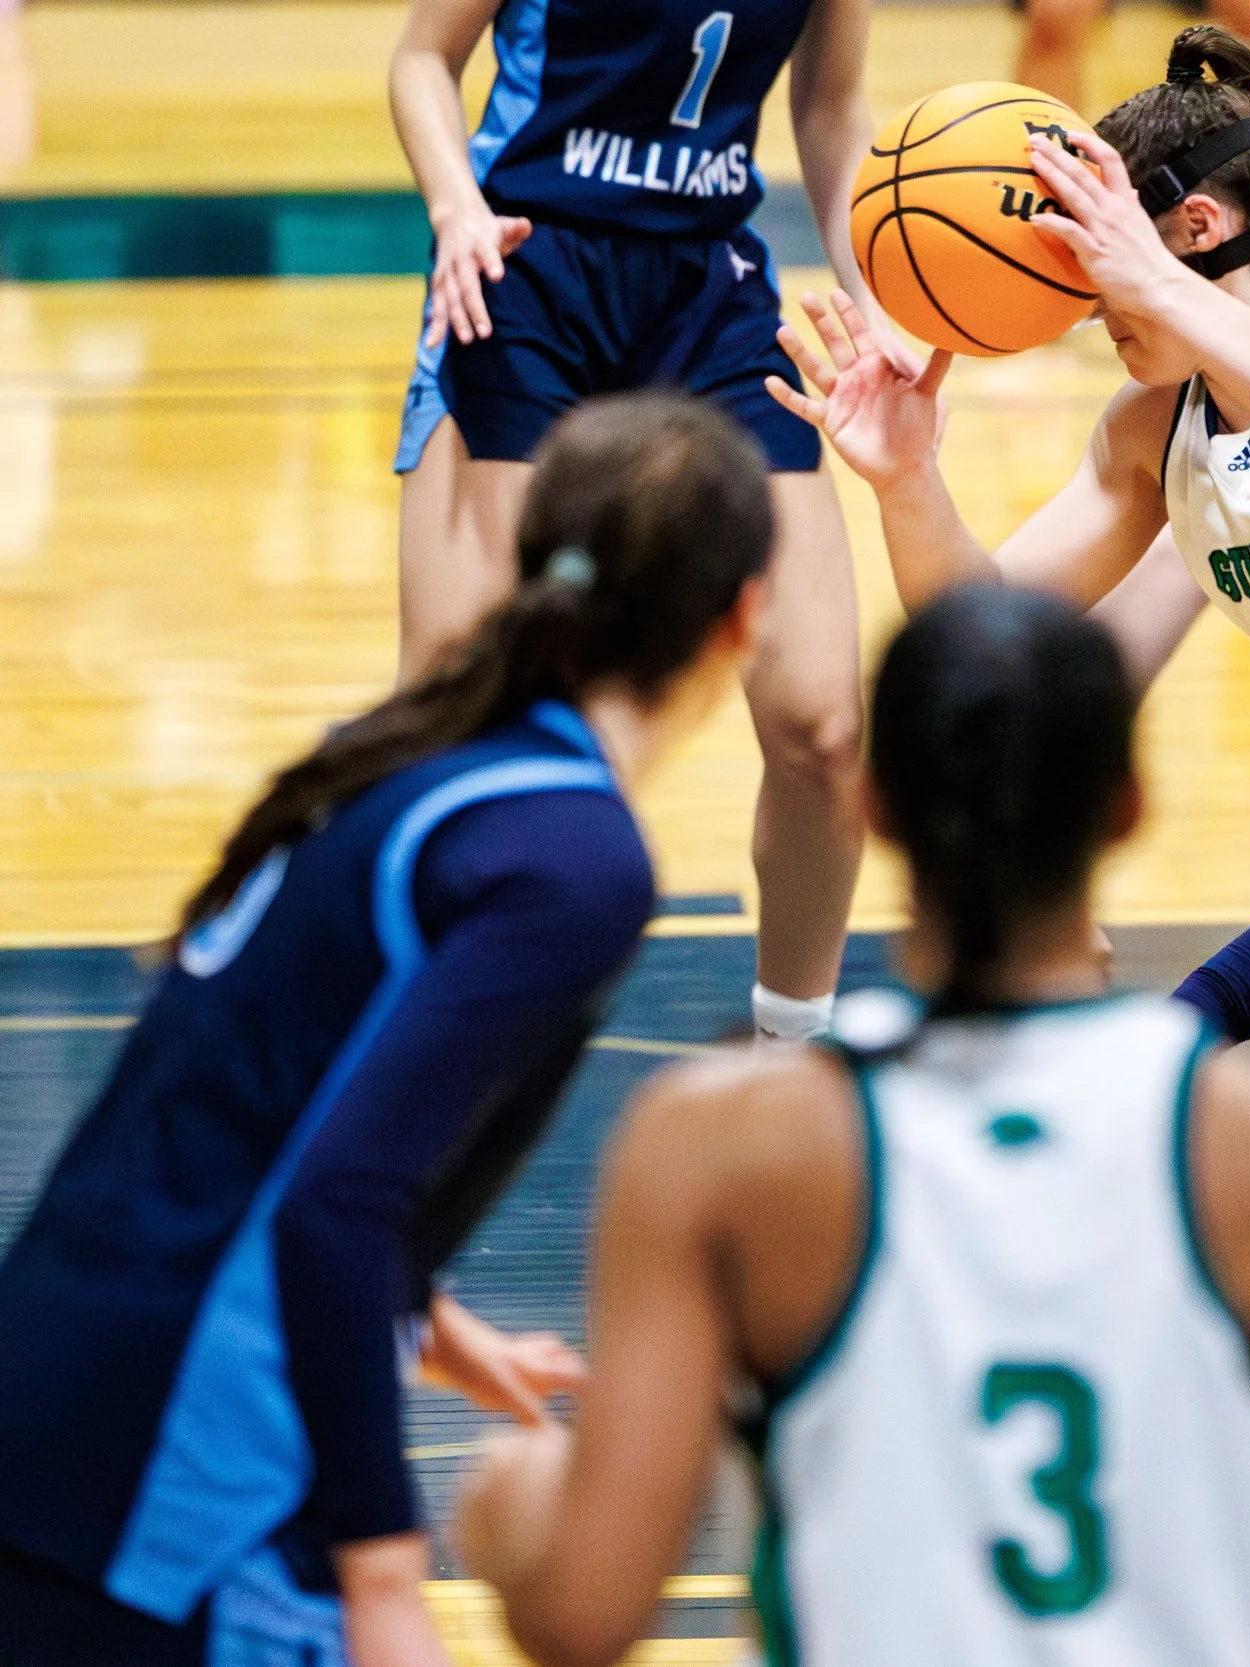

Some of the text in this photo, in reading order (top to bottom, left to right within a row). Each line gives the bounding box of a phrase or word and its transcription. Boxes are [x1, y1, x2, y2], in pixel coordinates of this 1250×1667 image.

[670, 11, 734, 129] 1
[563, 127, 748, 197] WILLIAMS
[982, 1362, 1108, 1617] 3
